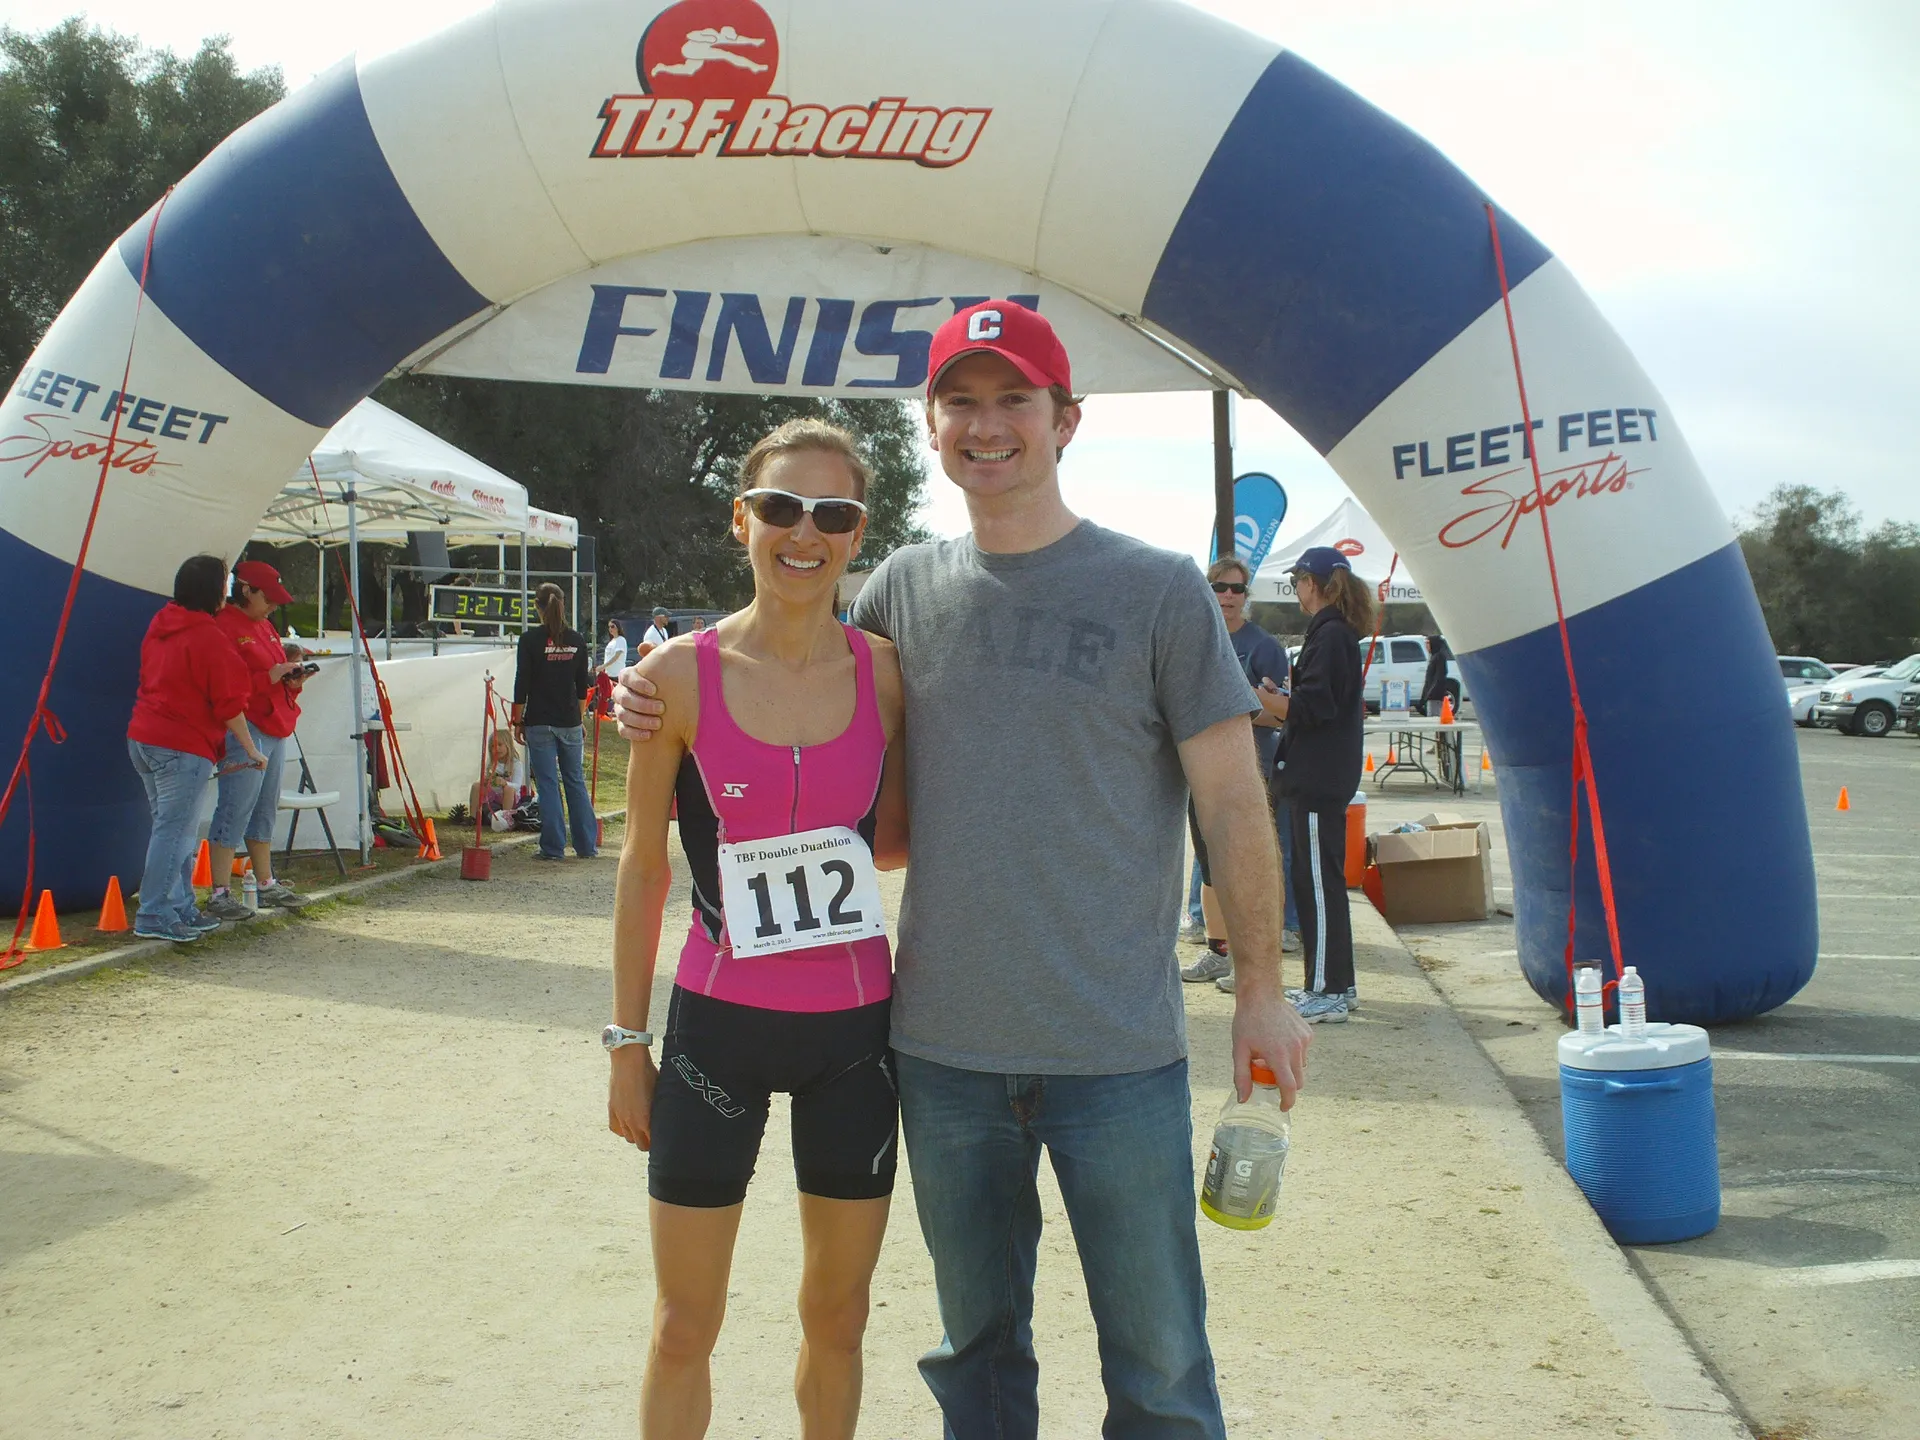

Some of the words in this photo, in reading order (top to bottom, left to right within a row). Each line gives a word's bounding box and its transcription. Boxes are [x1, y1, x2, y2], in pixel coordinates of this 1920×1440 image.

[592, 95, 736, 157] TBF
[720, 96, 992, 167] Racing
[575, 284, 1040, 388] FINIS
[966, 309, 1003, 342] C
[100, 390, 229, 444] FEET
[1393, 419, 1544, 480] FLEET
[1559, 408, 1657, 452] FEET
[1438, 451, 1652, 549] Sports
[1273, 582, 1297, 596] Tot
[734, 852, 757, 864] TBF
[758, 845, 799, 861] Double
[800, 836, 852, 853] Duathlon
[747, 859, 864, 939] 112
[671, 1055, 746, 1118] 2XU
[1235, 1160, 1253, 1177] G
